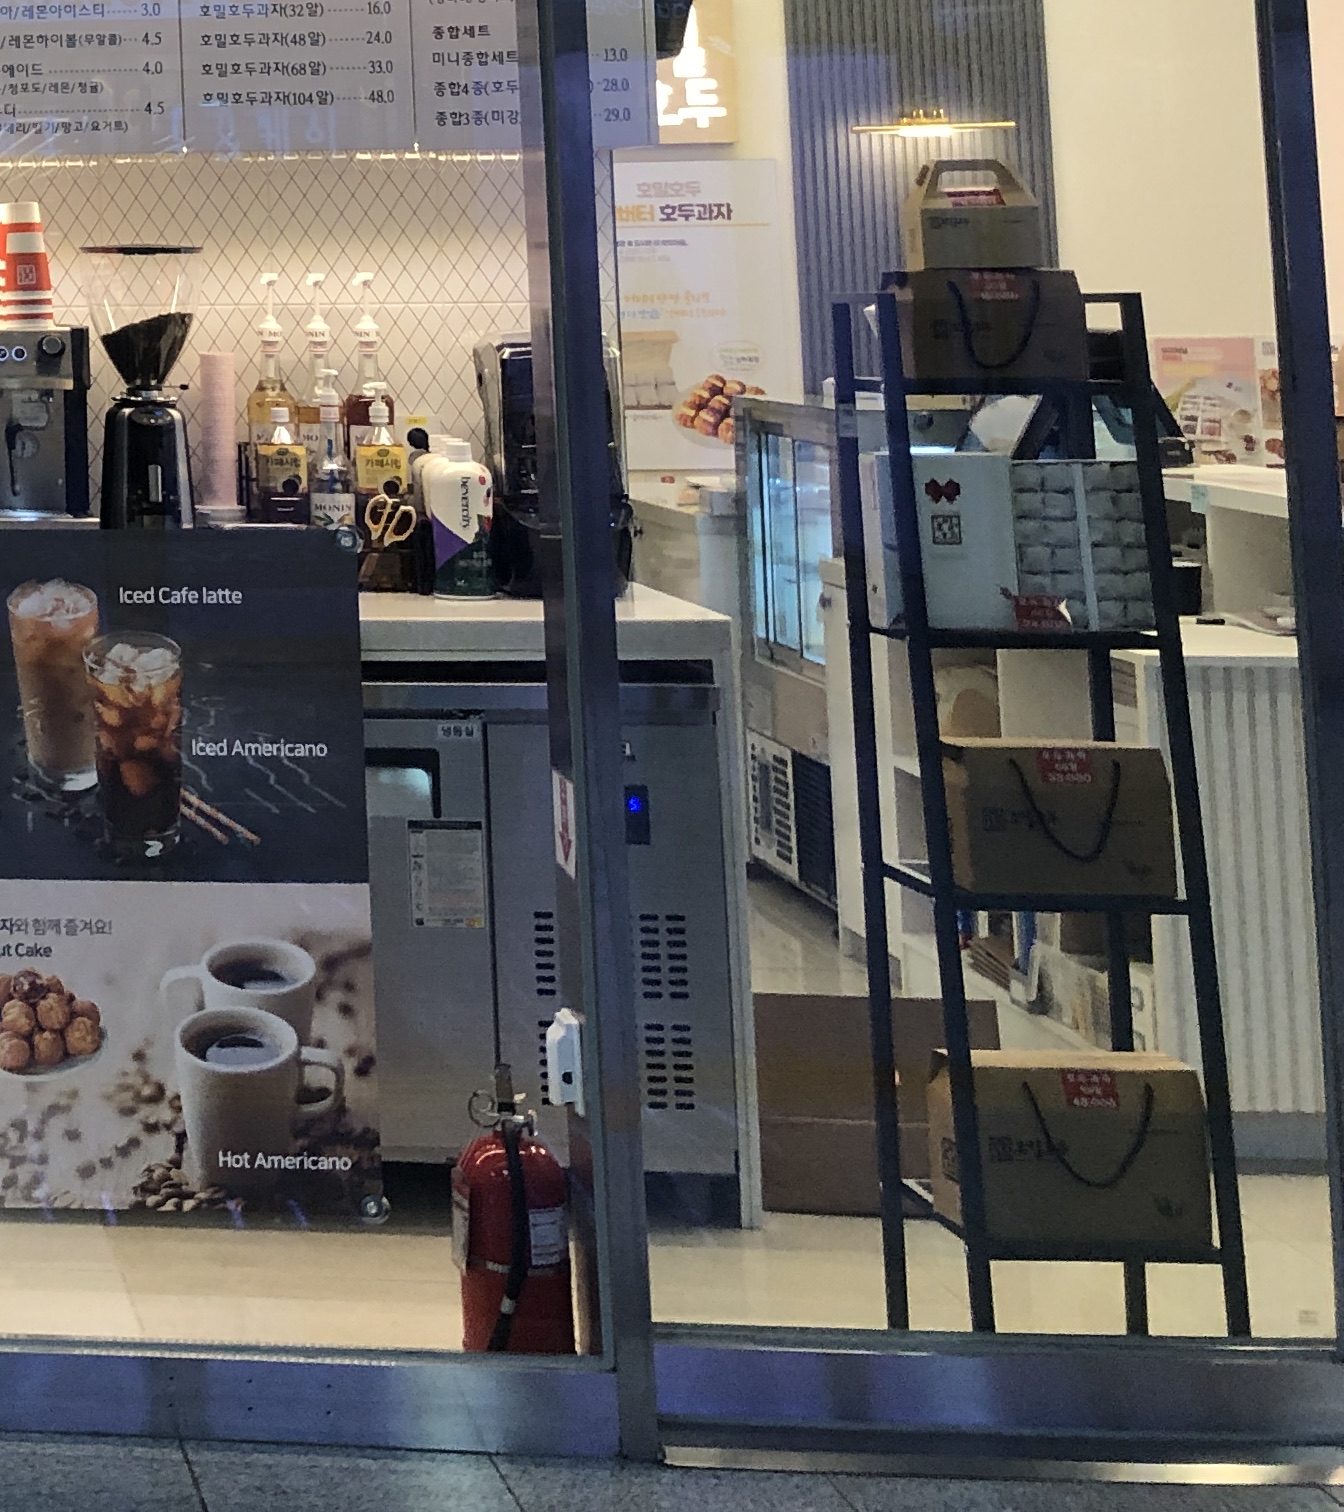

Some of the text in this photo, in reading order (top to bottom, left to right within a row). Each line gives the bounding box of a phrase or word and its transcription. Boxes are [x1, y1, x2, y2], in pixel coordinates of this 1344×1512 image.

[141, 4, 160, 16] 3.0
[142, 33, 162, 44] 4.5
[432, 25, 490, 39] 종합세트
[603, 48, 627, 62] 13.0
[368, 90, 394, 103] 48.0
[144, 103, 164, 115] 4.5
[659, 202, 733, 221] 호두과자
[314, 503, 352, 512] MONIN
[119, 586, 242, 604] Iced Cafe latte
[191, 738, 328, 759] Iced Americano
[32, 917, 61, 936] 함께
[15, 942, 52, 958] Cake
[218, 1150, 352, 1172] Hot Americano
